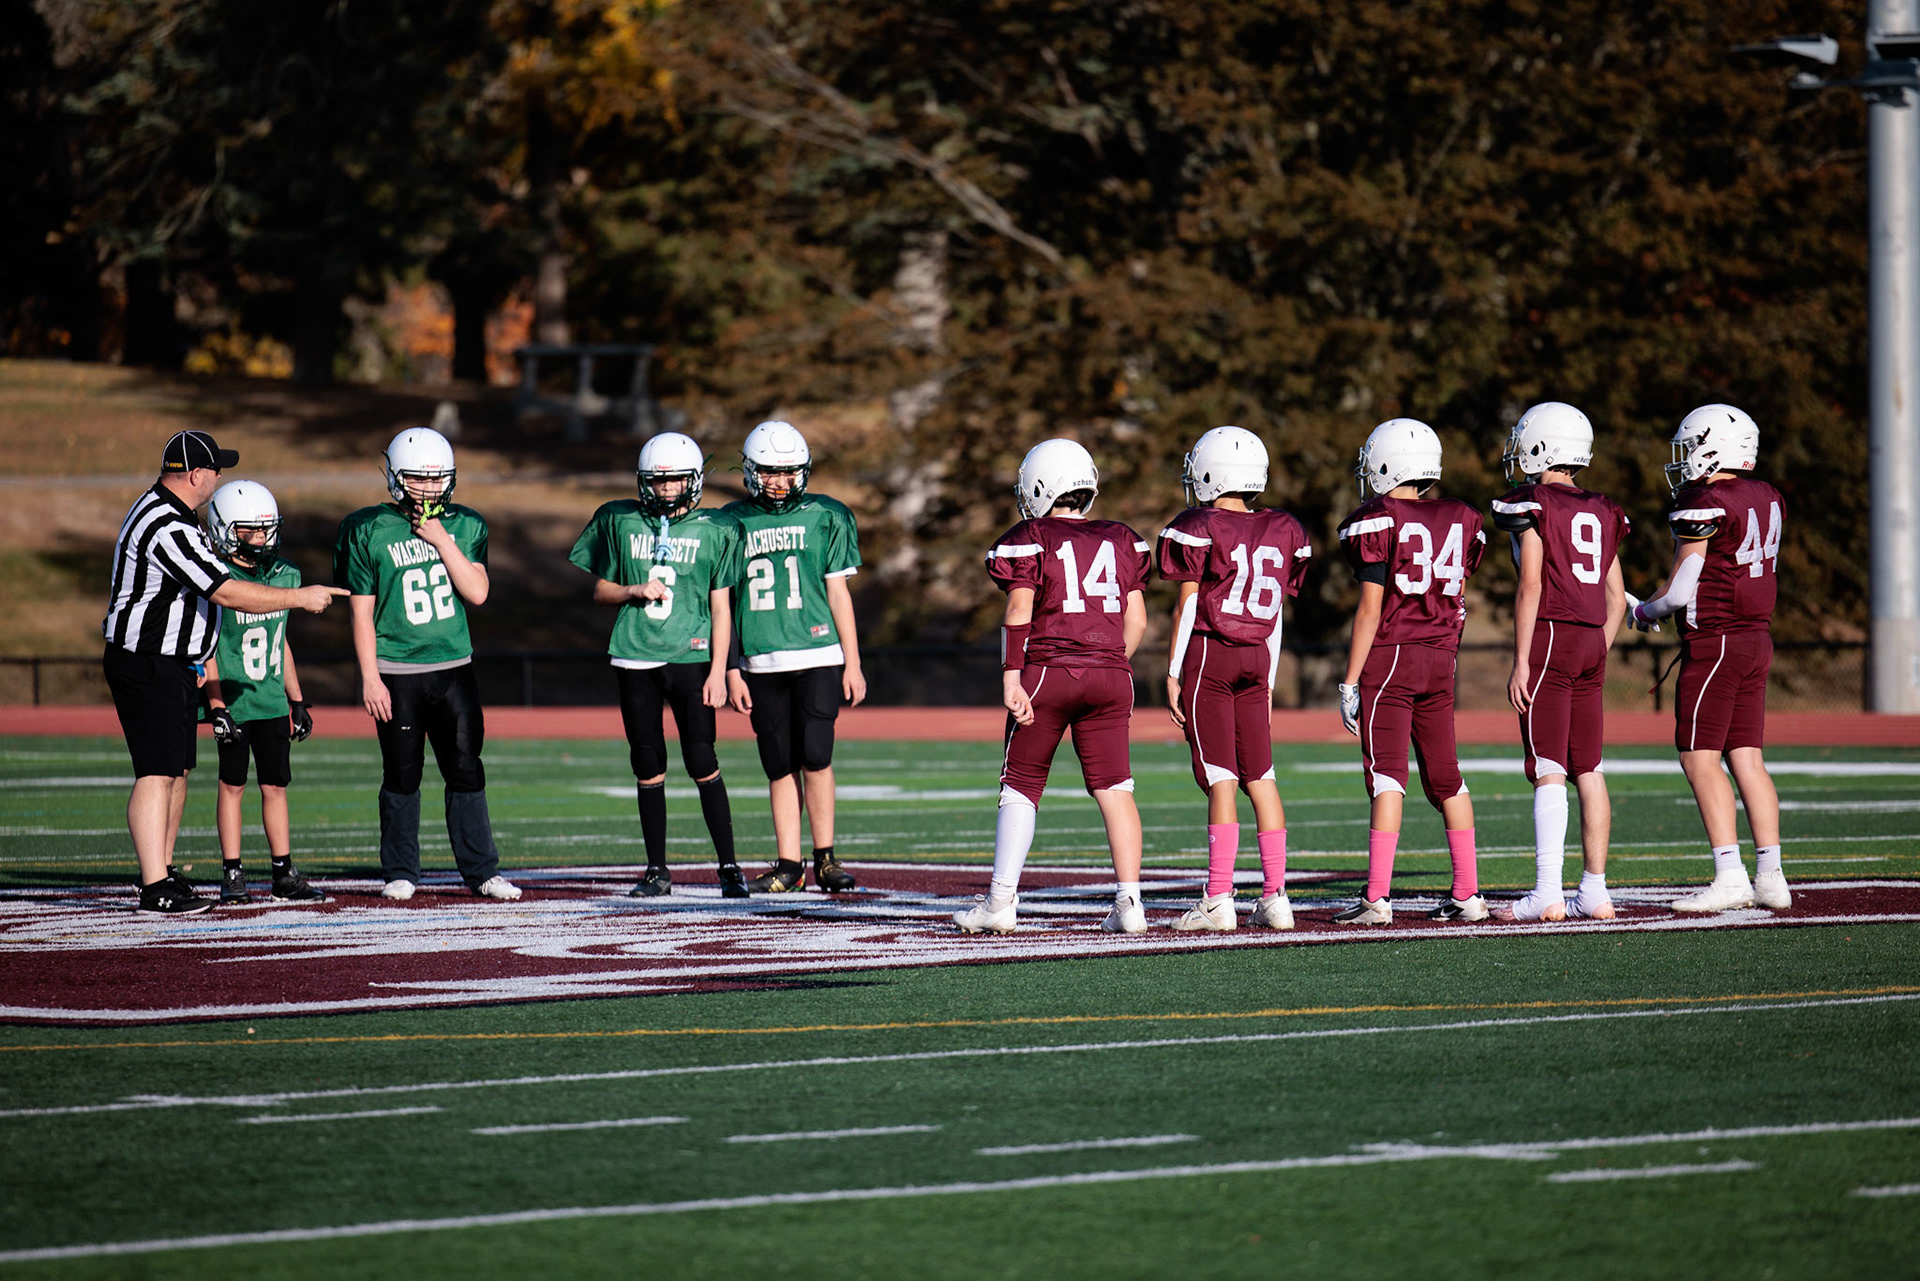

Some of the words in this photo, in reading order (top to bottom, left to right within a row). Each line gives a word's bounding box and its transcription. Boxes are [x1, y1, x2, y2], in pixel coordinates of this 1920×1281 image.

[387, 533, 456, 568] WACHUS
[630, 533, 701, 564] WACSETT
[1395, 522, 1464, 597] 34
[1571, 511, 1602, 584] 9
[1735, 501, 1782, 578] 44
[402, 563, 456, 626] 62
[644, 564, 676, 620] 6
[747, 555, 803, 611] 21
[1055, 539, 1121, 613] 14
[1220, 543, 1284, 620] 16
[241, 621, 284, 681] 84
